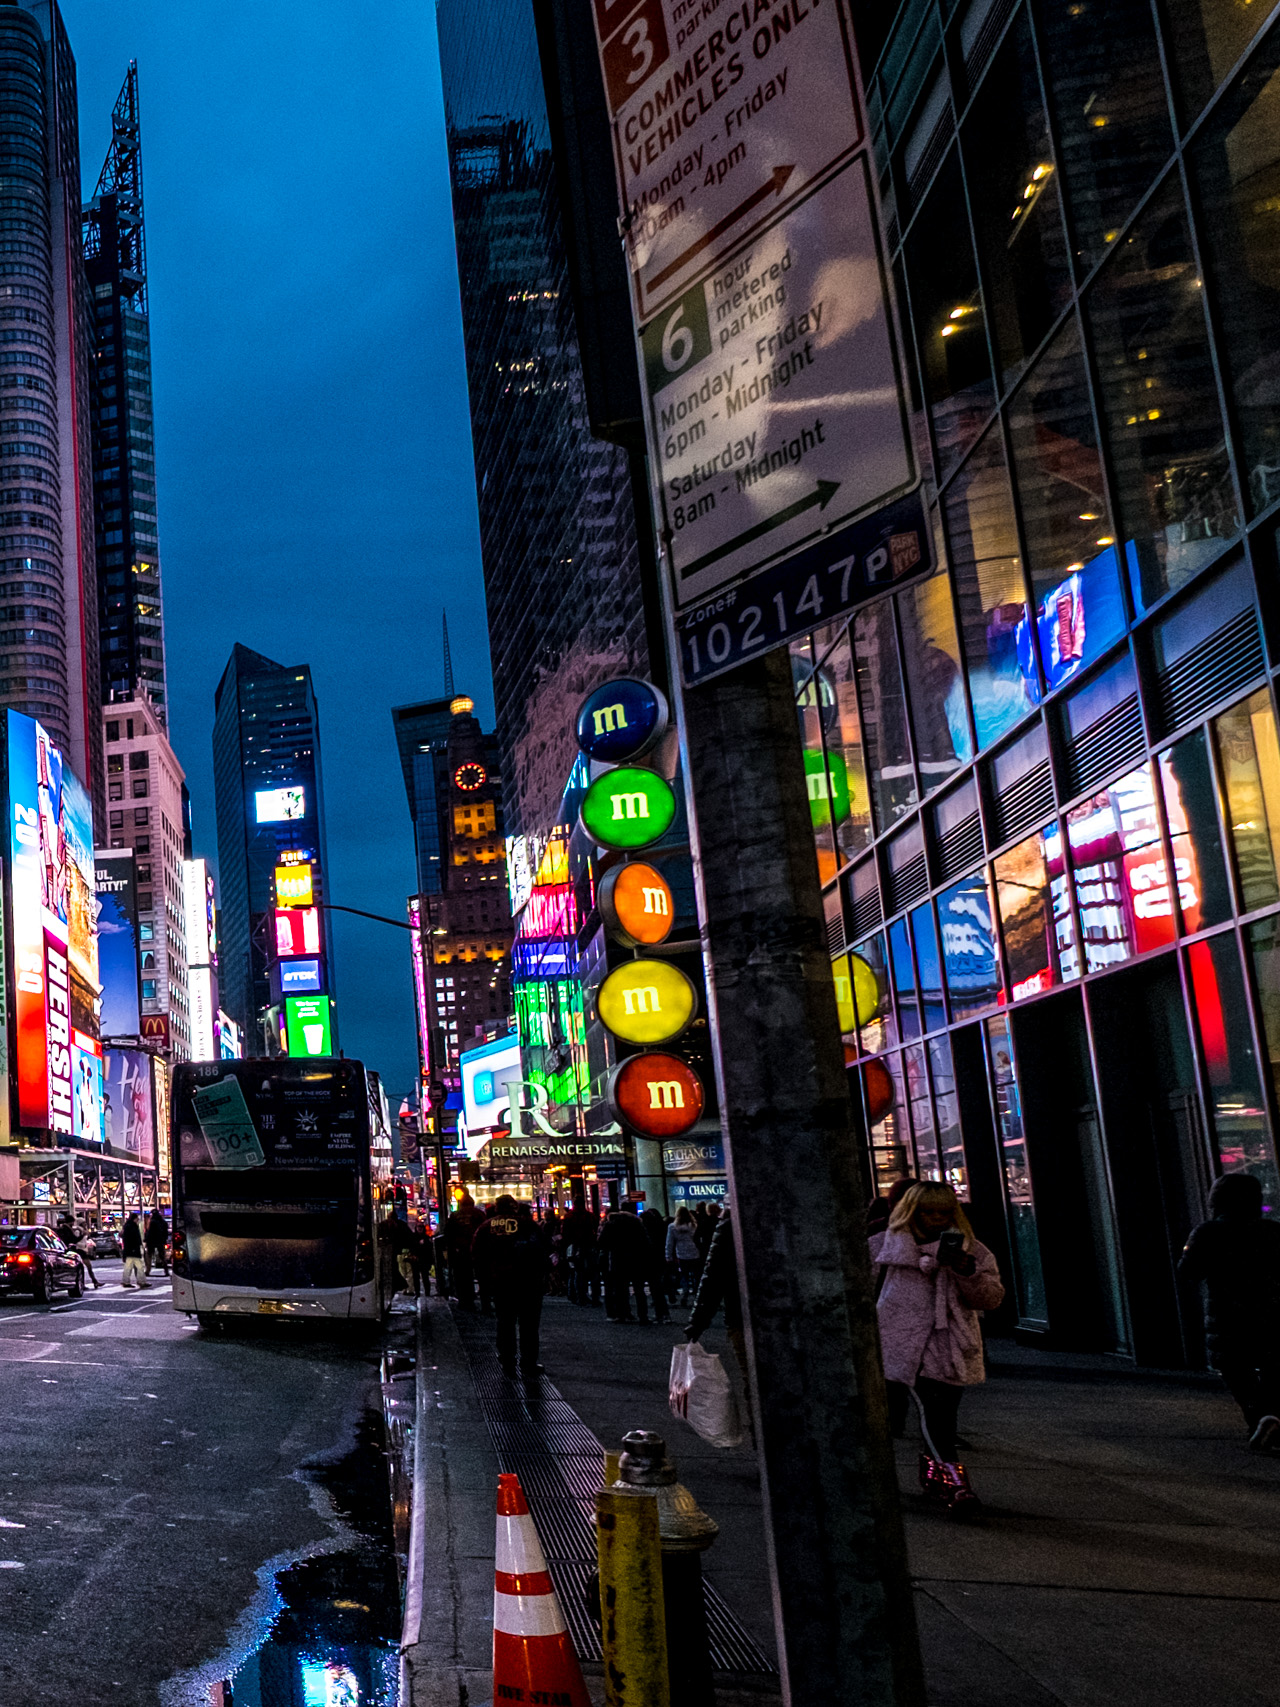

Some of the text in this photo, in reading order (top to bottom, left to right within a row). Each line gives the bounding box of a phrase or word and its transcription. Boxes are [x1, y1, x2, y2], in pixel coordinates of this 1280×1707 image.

[621, 16, 654, 86] 3
[624, 0, 778, 146] COMMERCIA
[628, 0, 819, 177] VEHICLES ONL
[632, 143, 704, 217] Monday
[724, 66, 788, 137] Friday
[703, 141, 747, 187] 4pm
[712, 254, 753, 300] hour
[715, 248, 793, 323] metered
[660, 303, 694, 373] 6
[718, 282, 786, 349] parking
[660, 369, 734, 432] Monday
[755, 301, 823, 366] Friday
[664, 418, 707, 460] 6pm
[725, 339, 816, 421] Midnight
[668, 429, 758, 501] Saturday
[673, 489, 716, 531] 8am
[735, 418, 826, 494] Midnight
[865, 546, 888, 582] P
[890, 533, 916, 551] PARK
[894, 548, 919, 573] NYC
[685, 588, 738, 630] Zone#
[687, 553, 856, 675] 102147
[592, 703, 629, 736] m
[610, 792, 650, 820] m
[642, 886, 668, 916] m
[622, 985, 662, 1015] m
[198, 1065, 219, 1077] 186
[646, 1080, 685, 1109] m
[492, 1144, 584, 1157] RENAISSANCE
[688, 1184, 726, 1196] CHANGE
[490, 1218, 505, 1226] BIG
